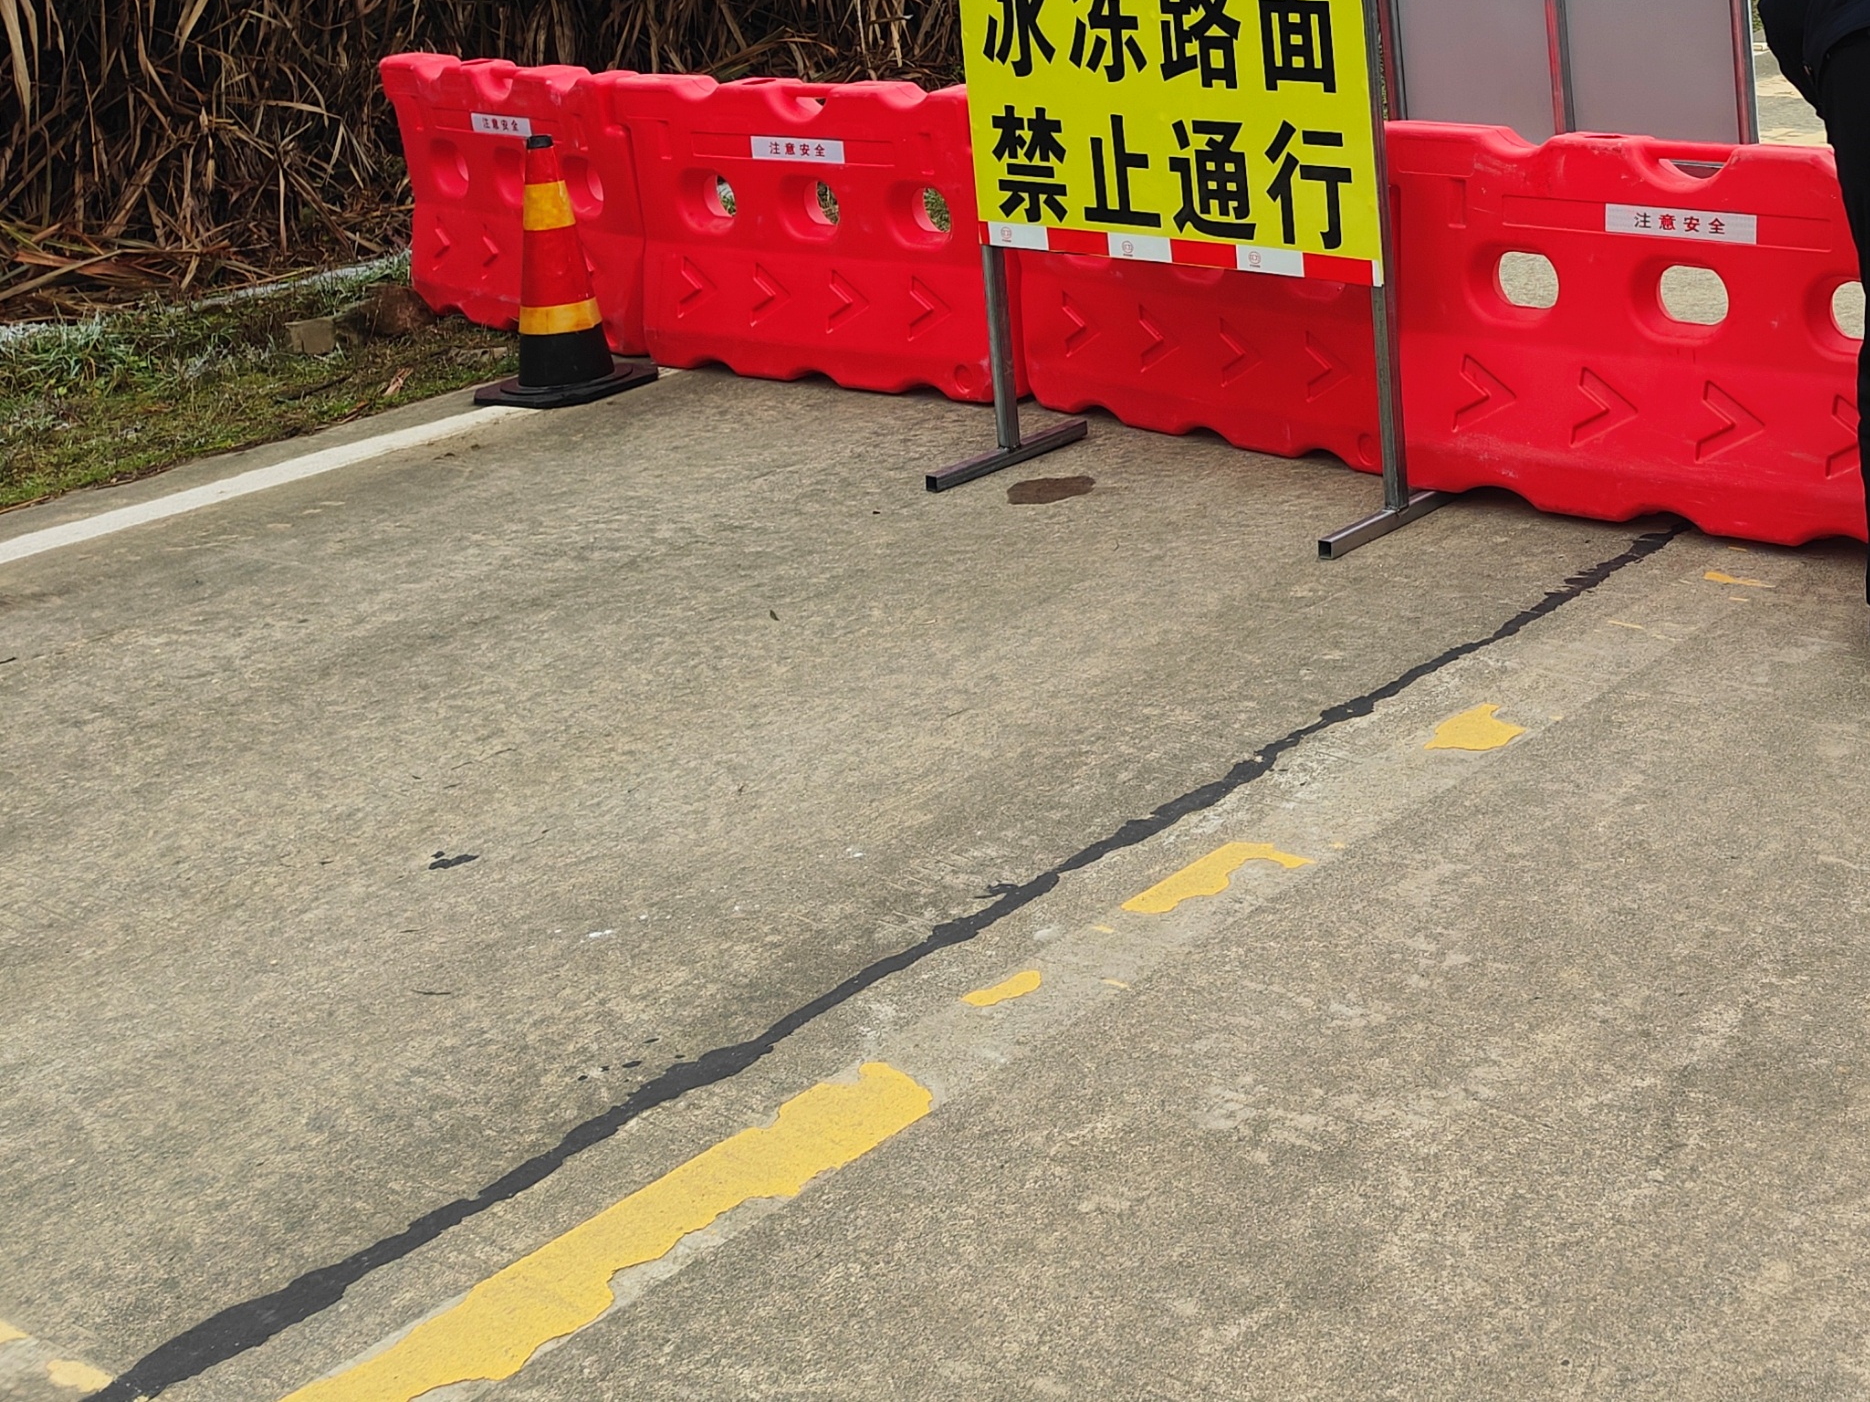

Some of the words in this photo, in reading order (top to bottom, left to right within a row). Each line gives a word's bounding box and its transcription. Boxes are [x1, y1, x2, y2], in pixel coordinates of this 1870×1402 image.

[482, 117, 519, 132] 注意安全
[768, 141, 826, 158] 注意安全
[991, 104, 1353, 250] 禁止通行
[1633, 211, 1726, 235] 注意安全
